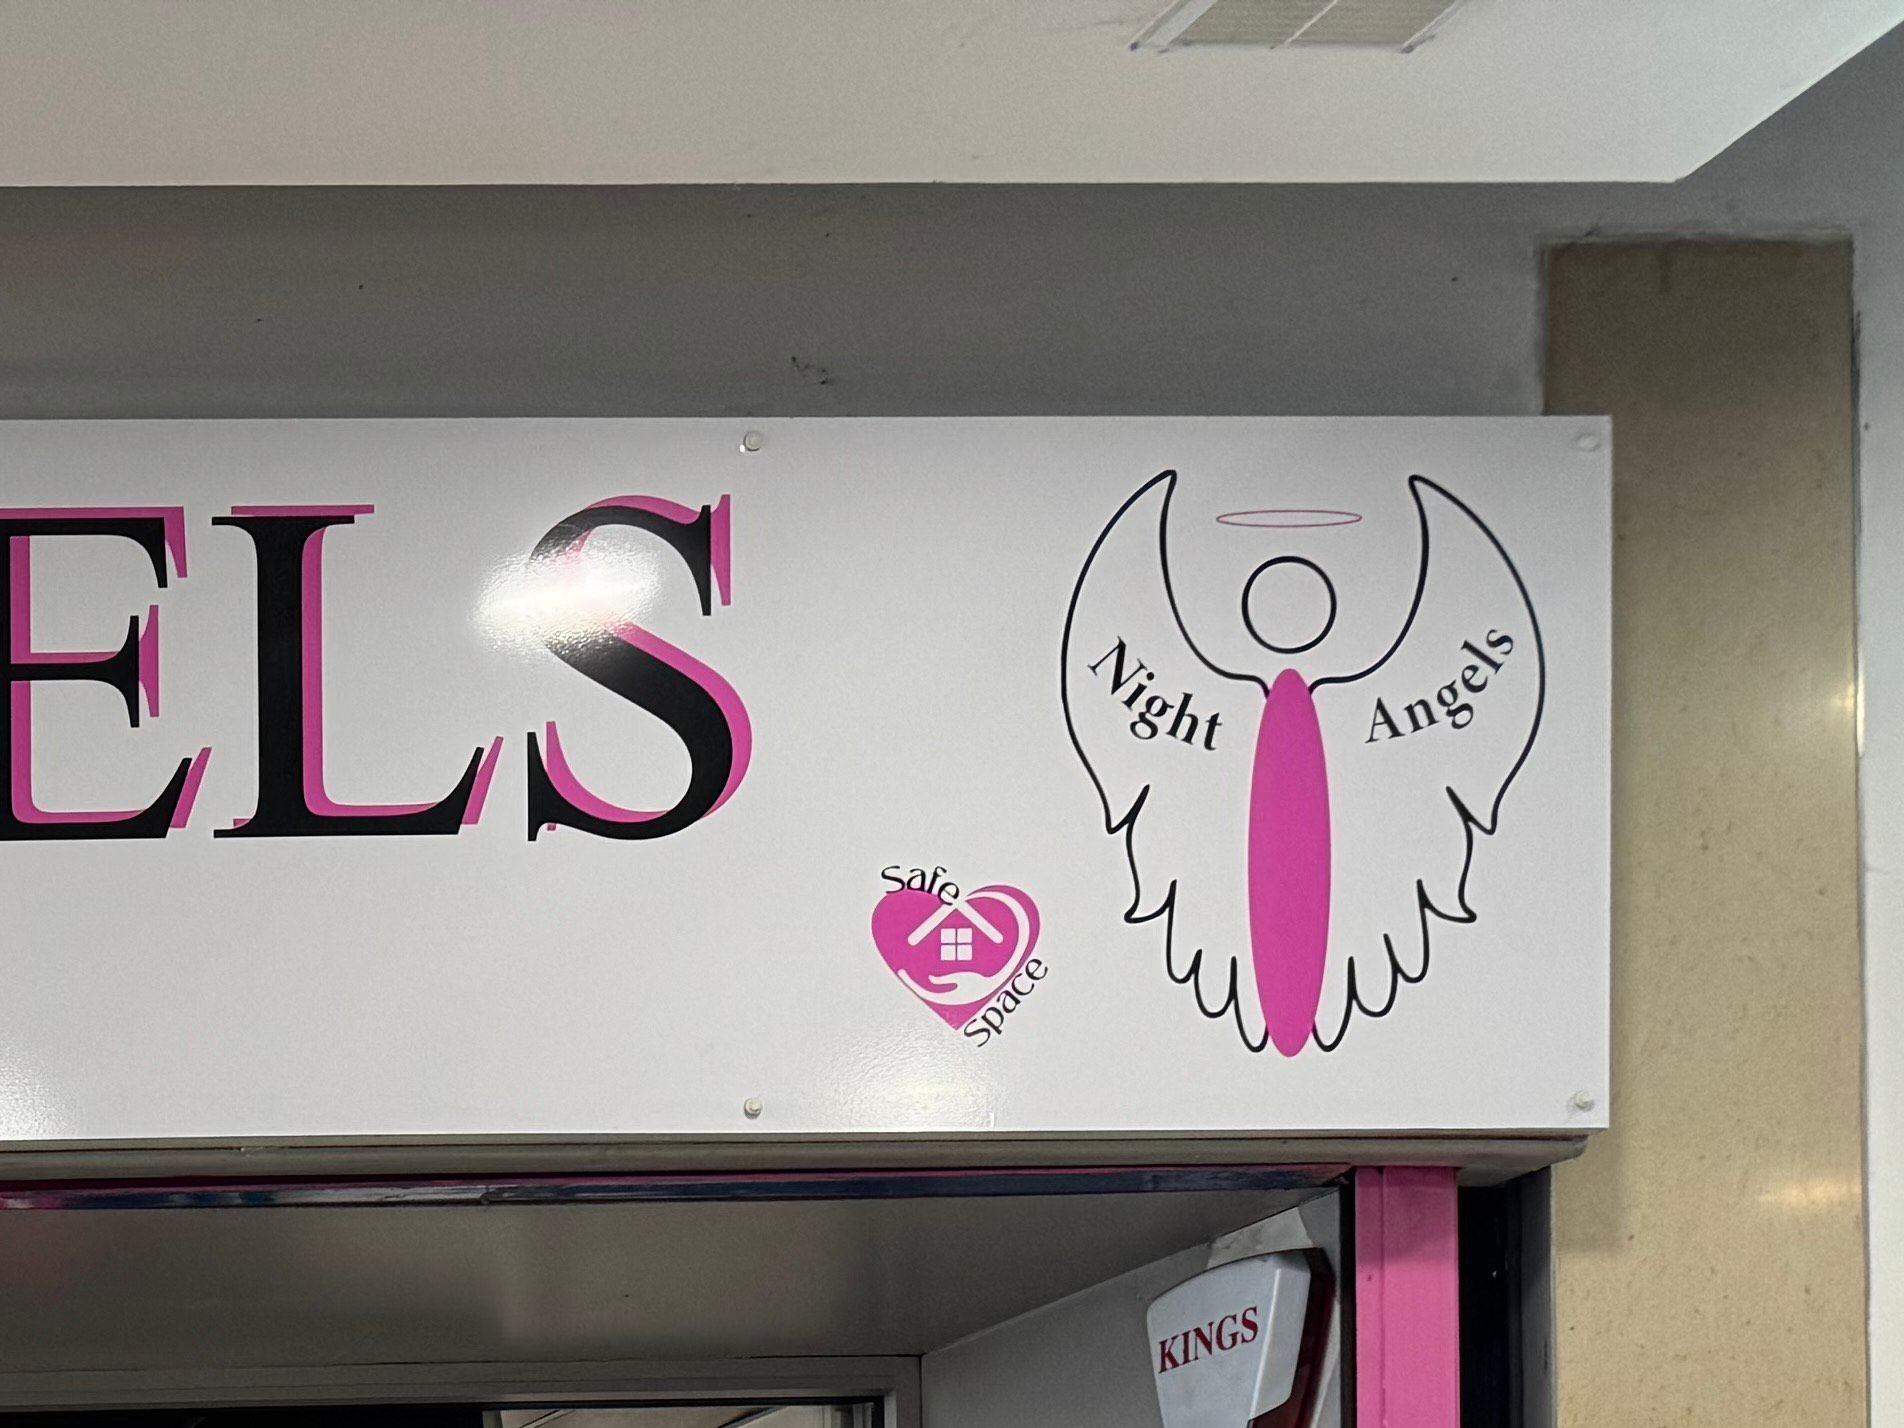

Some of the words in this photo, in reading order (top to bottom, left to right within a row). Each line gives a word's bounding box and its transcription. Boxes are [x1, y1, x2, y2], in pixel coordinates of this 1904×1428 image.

[1087, 638, 1223, 753] Night
[1366, 626, 1515, 744] Angels
[880, 864, 960, 905] Safe
[964, 958, 1048, 1047] Space
[1158, 1306, 1259, 1374] KINGS
